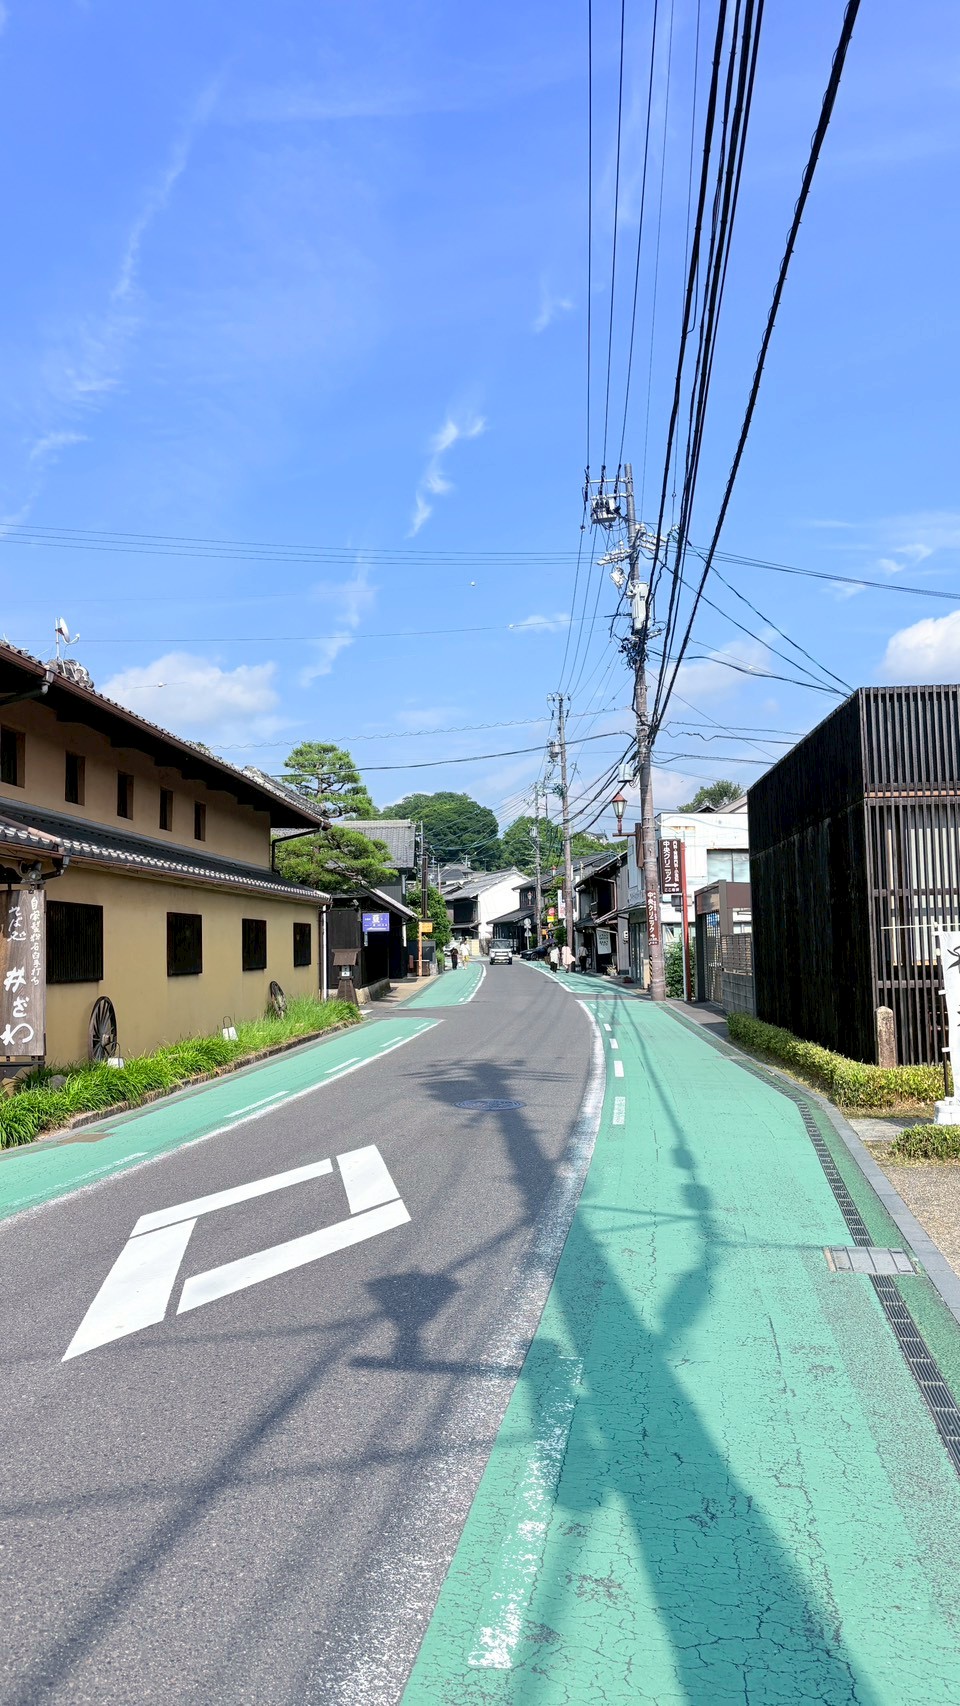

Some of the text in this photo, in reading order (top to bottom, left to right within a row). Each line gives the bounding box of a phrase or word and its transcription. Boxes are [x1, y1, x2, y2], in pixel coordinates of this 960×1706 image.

[663, 841, 671, 883] 中央クリニック
[7, 906, 26, 941] そば処
